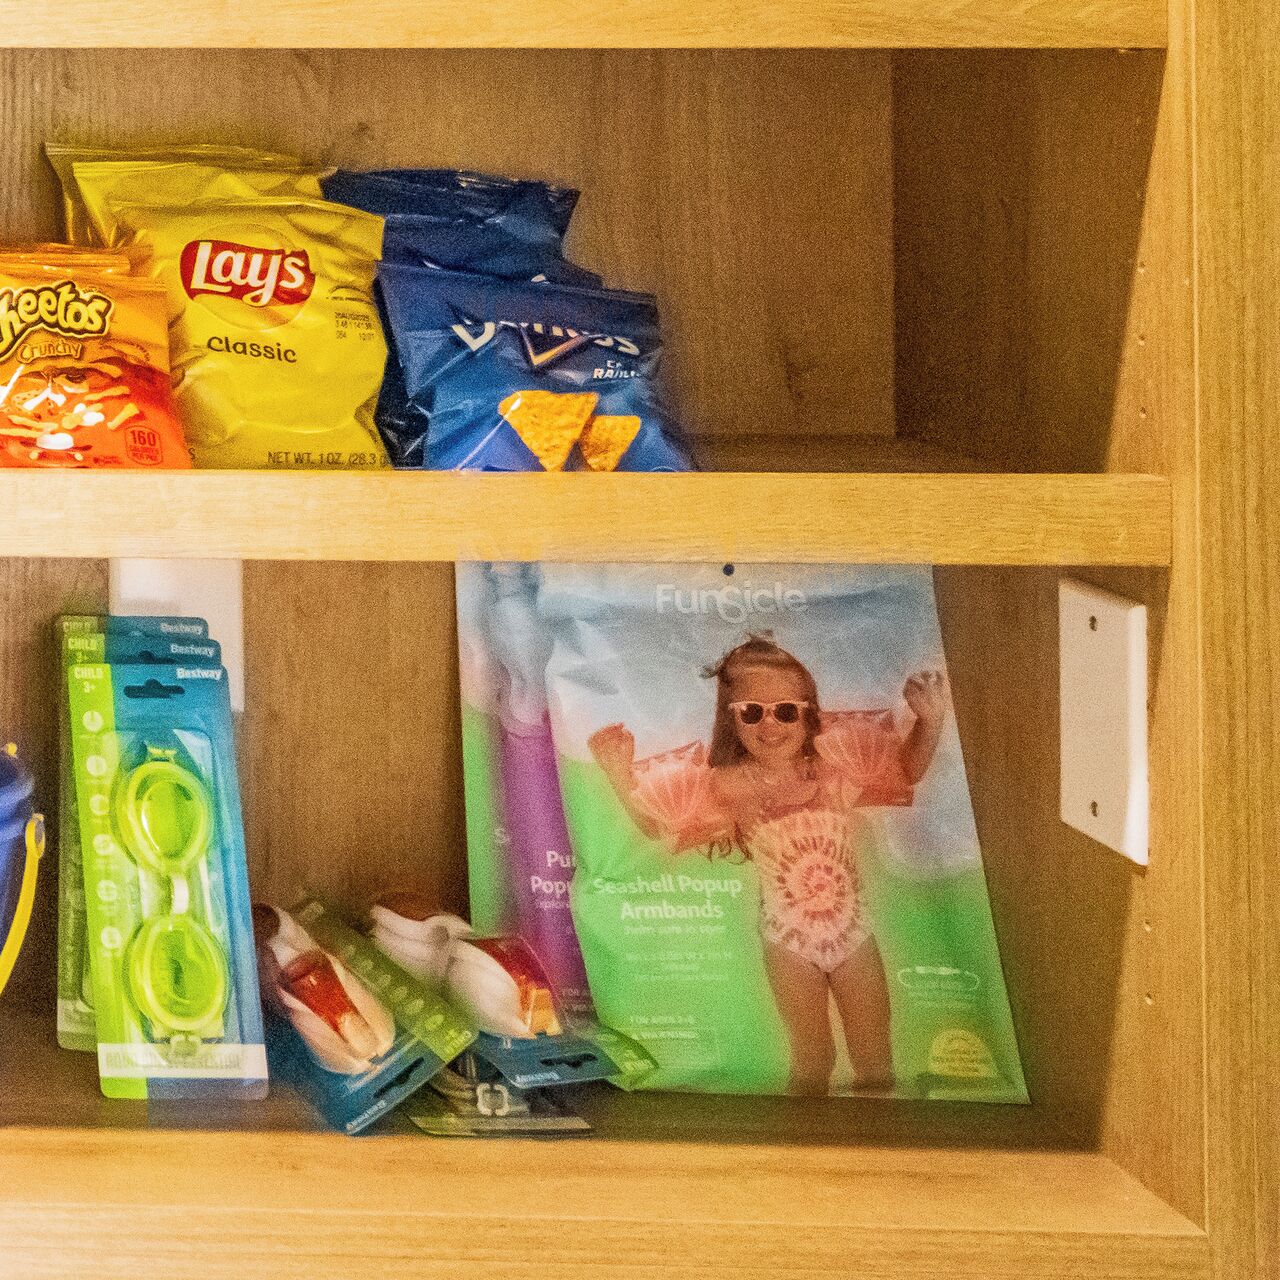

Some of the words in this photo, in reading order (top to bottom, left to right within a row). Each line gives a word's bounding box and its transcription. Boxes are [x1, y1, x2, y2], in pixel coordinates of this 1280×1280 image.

[17, 341, 82, 363] Crunchy
[207, 336, 298, 364] Classic
[129, 428, 157, 446] 160
[267, 451, 292, 464] NET
[294, 452, 316, 465] WT.
[656, 583, 808, 623] Funsicle
[176, 667, 222, 681] Bestway
[592, 875, 675, 896] Seashell
[679, 877, 742, 900] Popup
[620, 902, 724, 920] Armbands
